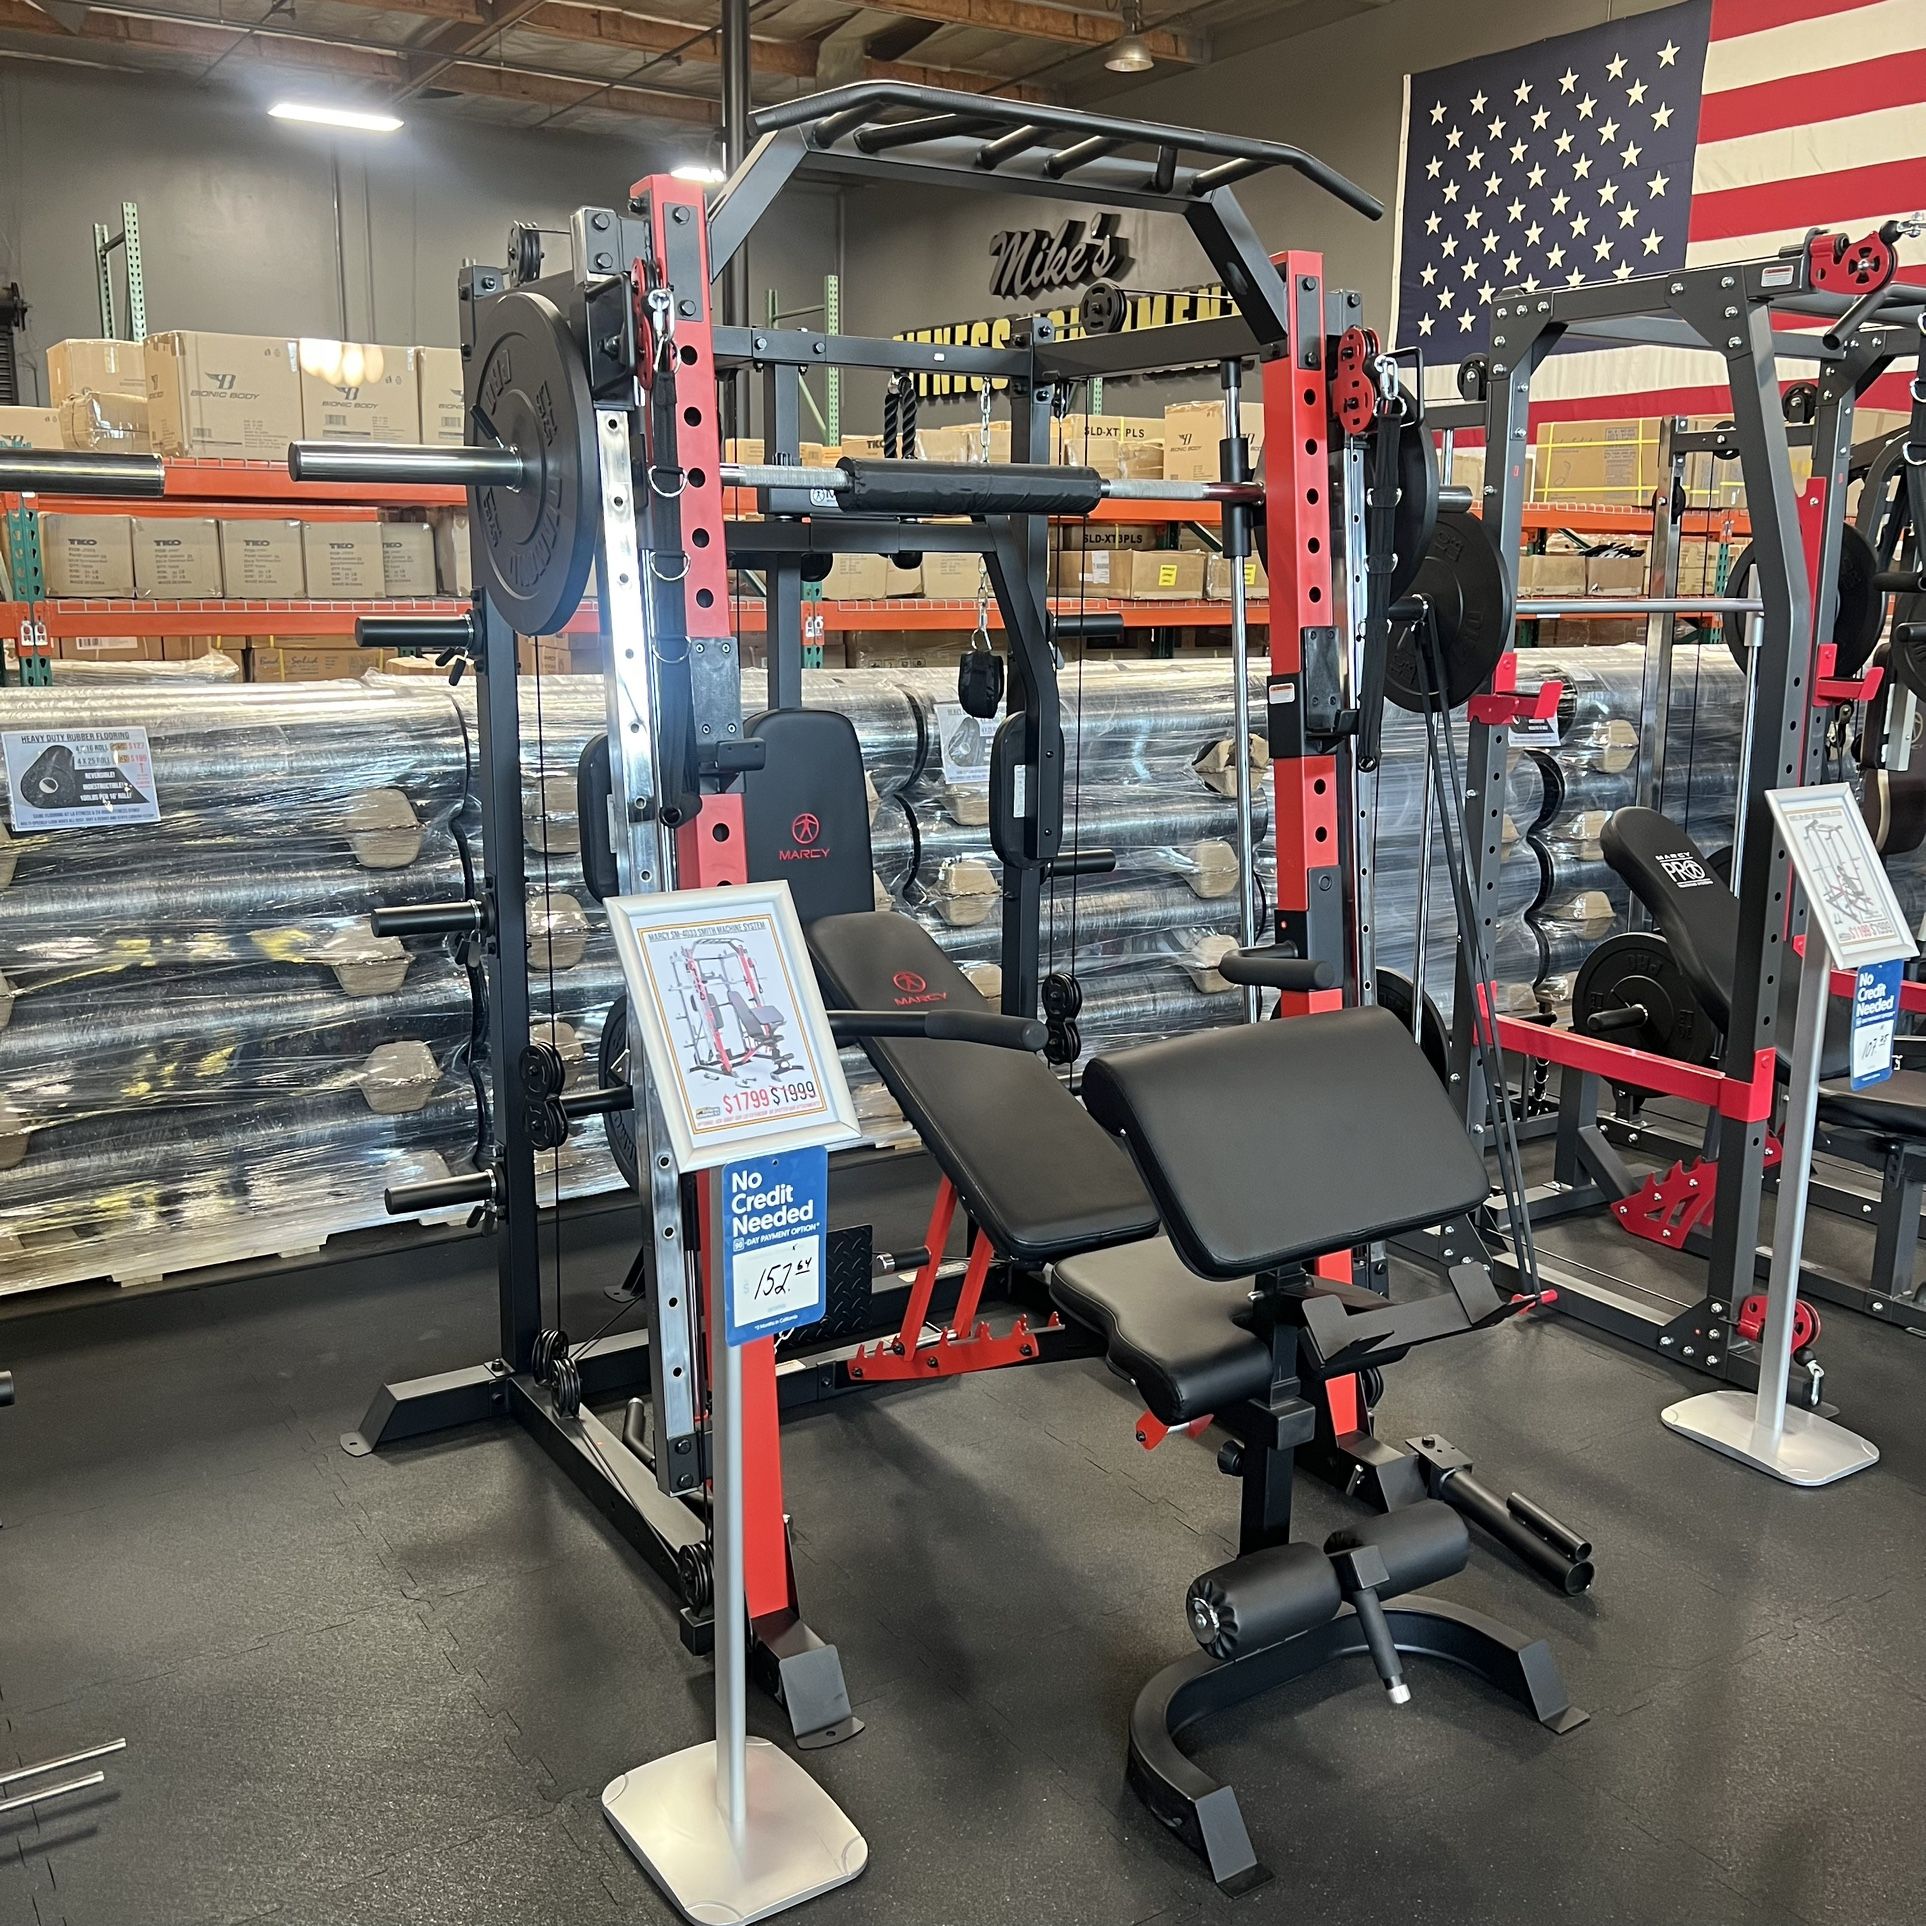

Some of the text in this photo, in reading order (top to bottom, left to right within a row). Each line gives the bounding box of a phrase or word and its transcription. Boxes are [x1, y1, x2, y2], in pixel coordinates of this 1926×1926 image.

[989, 212, 1124, 298] Mike's
[893, 318, 1010, 397] TNESS
[190, 390, 260, 400] BIONIC BODY
[1084, 426, 1145, 438] SLD-XTPLS
[68, 538, 97, 546] TKO
[21, 731, 130, 743] HEAVY DUTY RUBBER FLOORING
[779, 848, 831, 861] MARCY
[1655, 851, 1690, 860] MARCY
[1661, 860, 1706, 882] PRO
[648, 932, 670, 942] MARCY
[698, 926, 716, 937] SMITH
[717, 924, 741, 935] MACHINE
[743, 921, 766, 932] SYSTEM
[1860, 972, 1874, 987] No
[893, 992, 947, 1006] MARCY
[1858, 983, 1886, 1002] Credit
[1856, 995, 1894, 1017] Needed
[723, 1089, 770, 1114] $1799
[771, 1081, 816, 1105] $1999
[731, 1170, 763, 1193] No
[731, 1183, 794, 1215] Credit
[732, 1199, 814, 1238] Needed
[760, 1229, 790, 1244] PAYMENT
